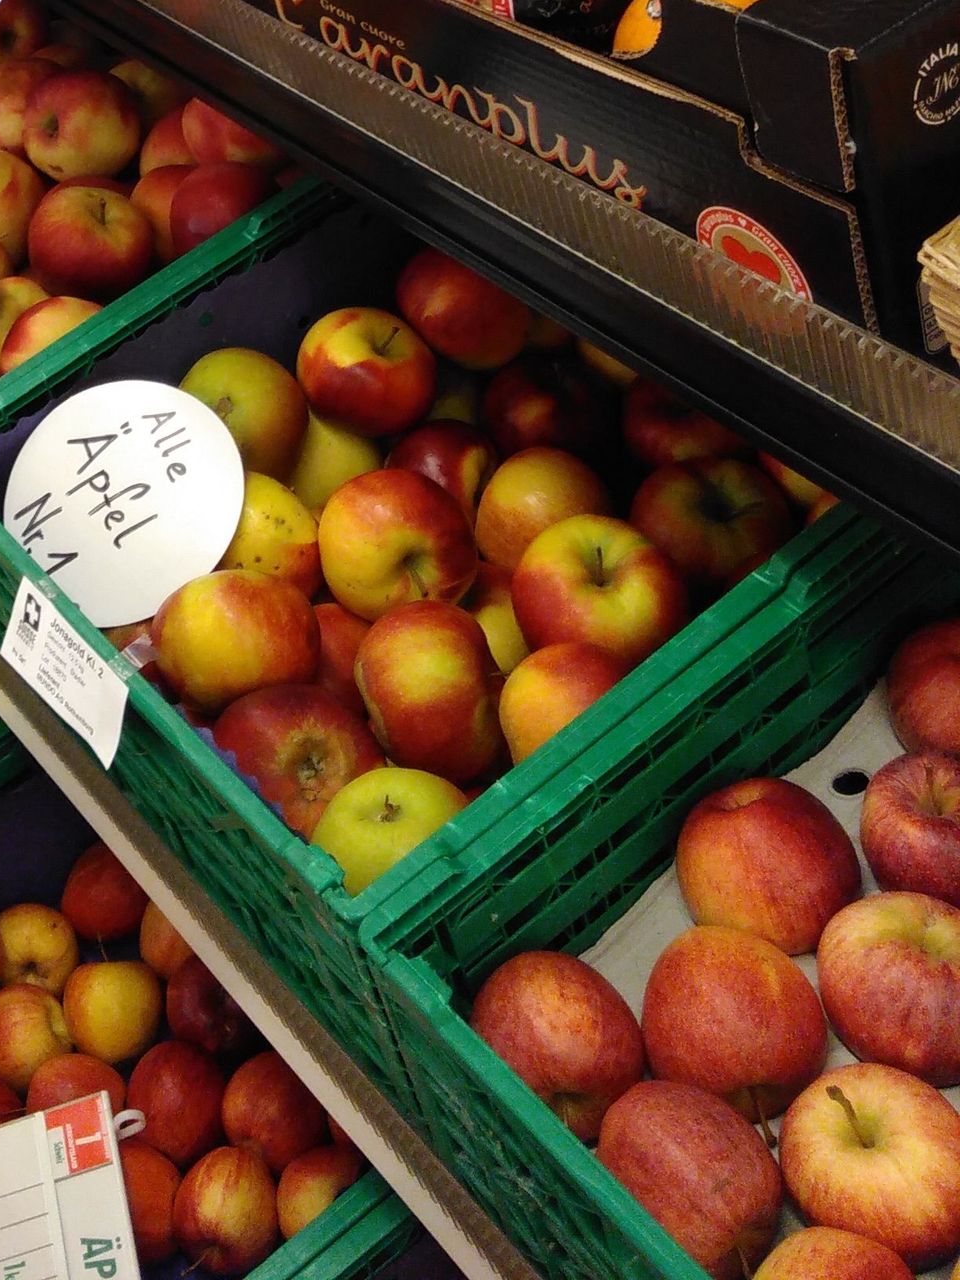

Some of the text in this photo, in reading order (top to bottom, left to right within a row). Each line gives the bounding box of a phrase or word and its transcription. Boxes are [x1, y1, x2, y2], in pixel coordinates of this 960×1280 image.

[360, 19, 407, 51] cuore
[141, 411, 192, 483] Alle
[66, 421, 159, 550] Äpfel
[50, 618, 86, 660] Jonagold
